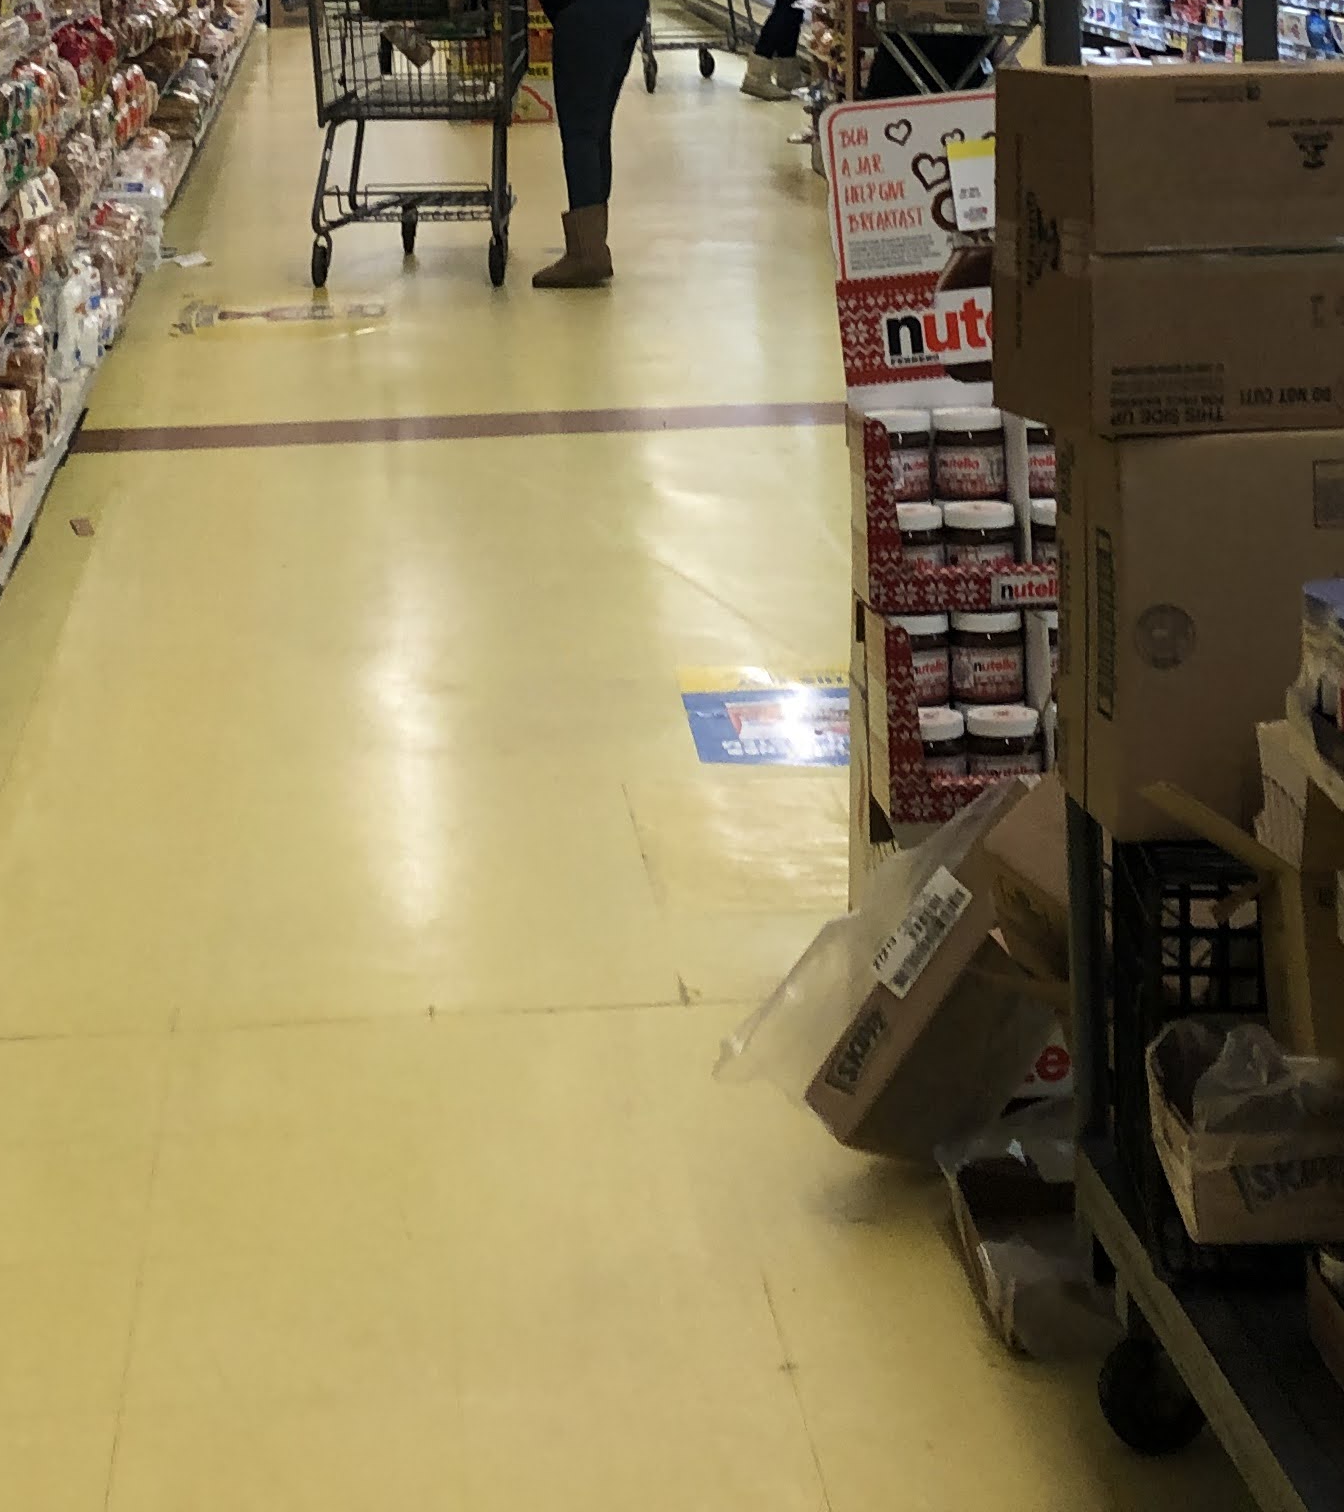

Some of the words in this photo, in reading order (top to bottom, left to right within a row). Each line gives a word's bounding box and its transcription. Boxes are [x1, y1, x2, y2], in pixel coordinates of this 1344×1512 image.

[839, 128, 869, 148] BUY
[854, 154, 882, 177] JAR
[844, 181, 877, 206] HELP
[878, 180, 906, 202] GIVE
[847, 206, 924, 234] BREAKFAST
[886, 298, 993, 357] nut
